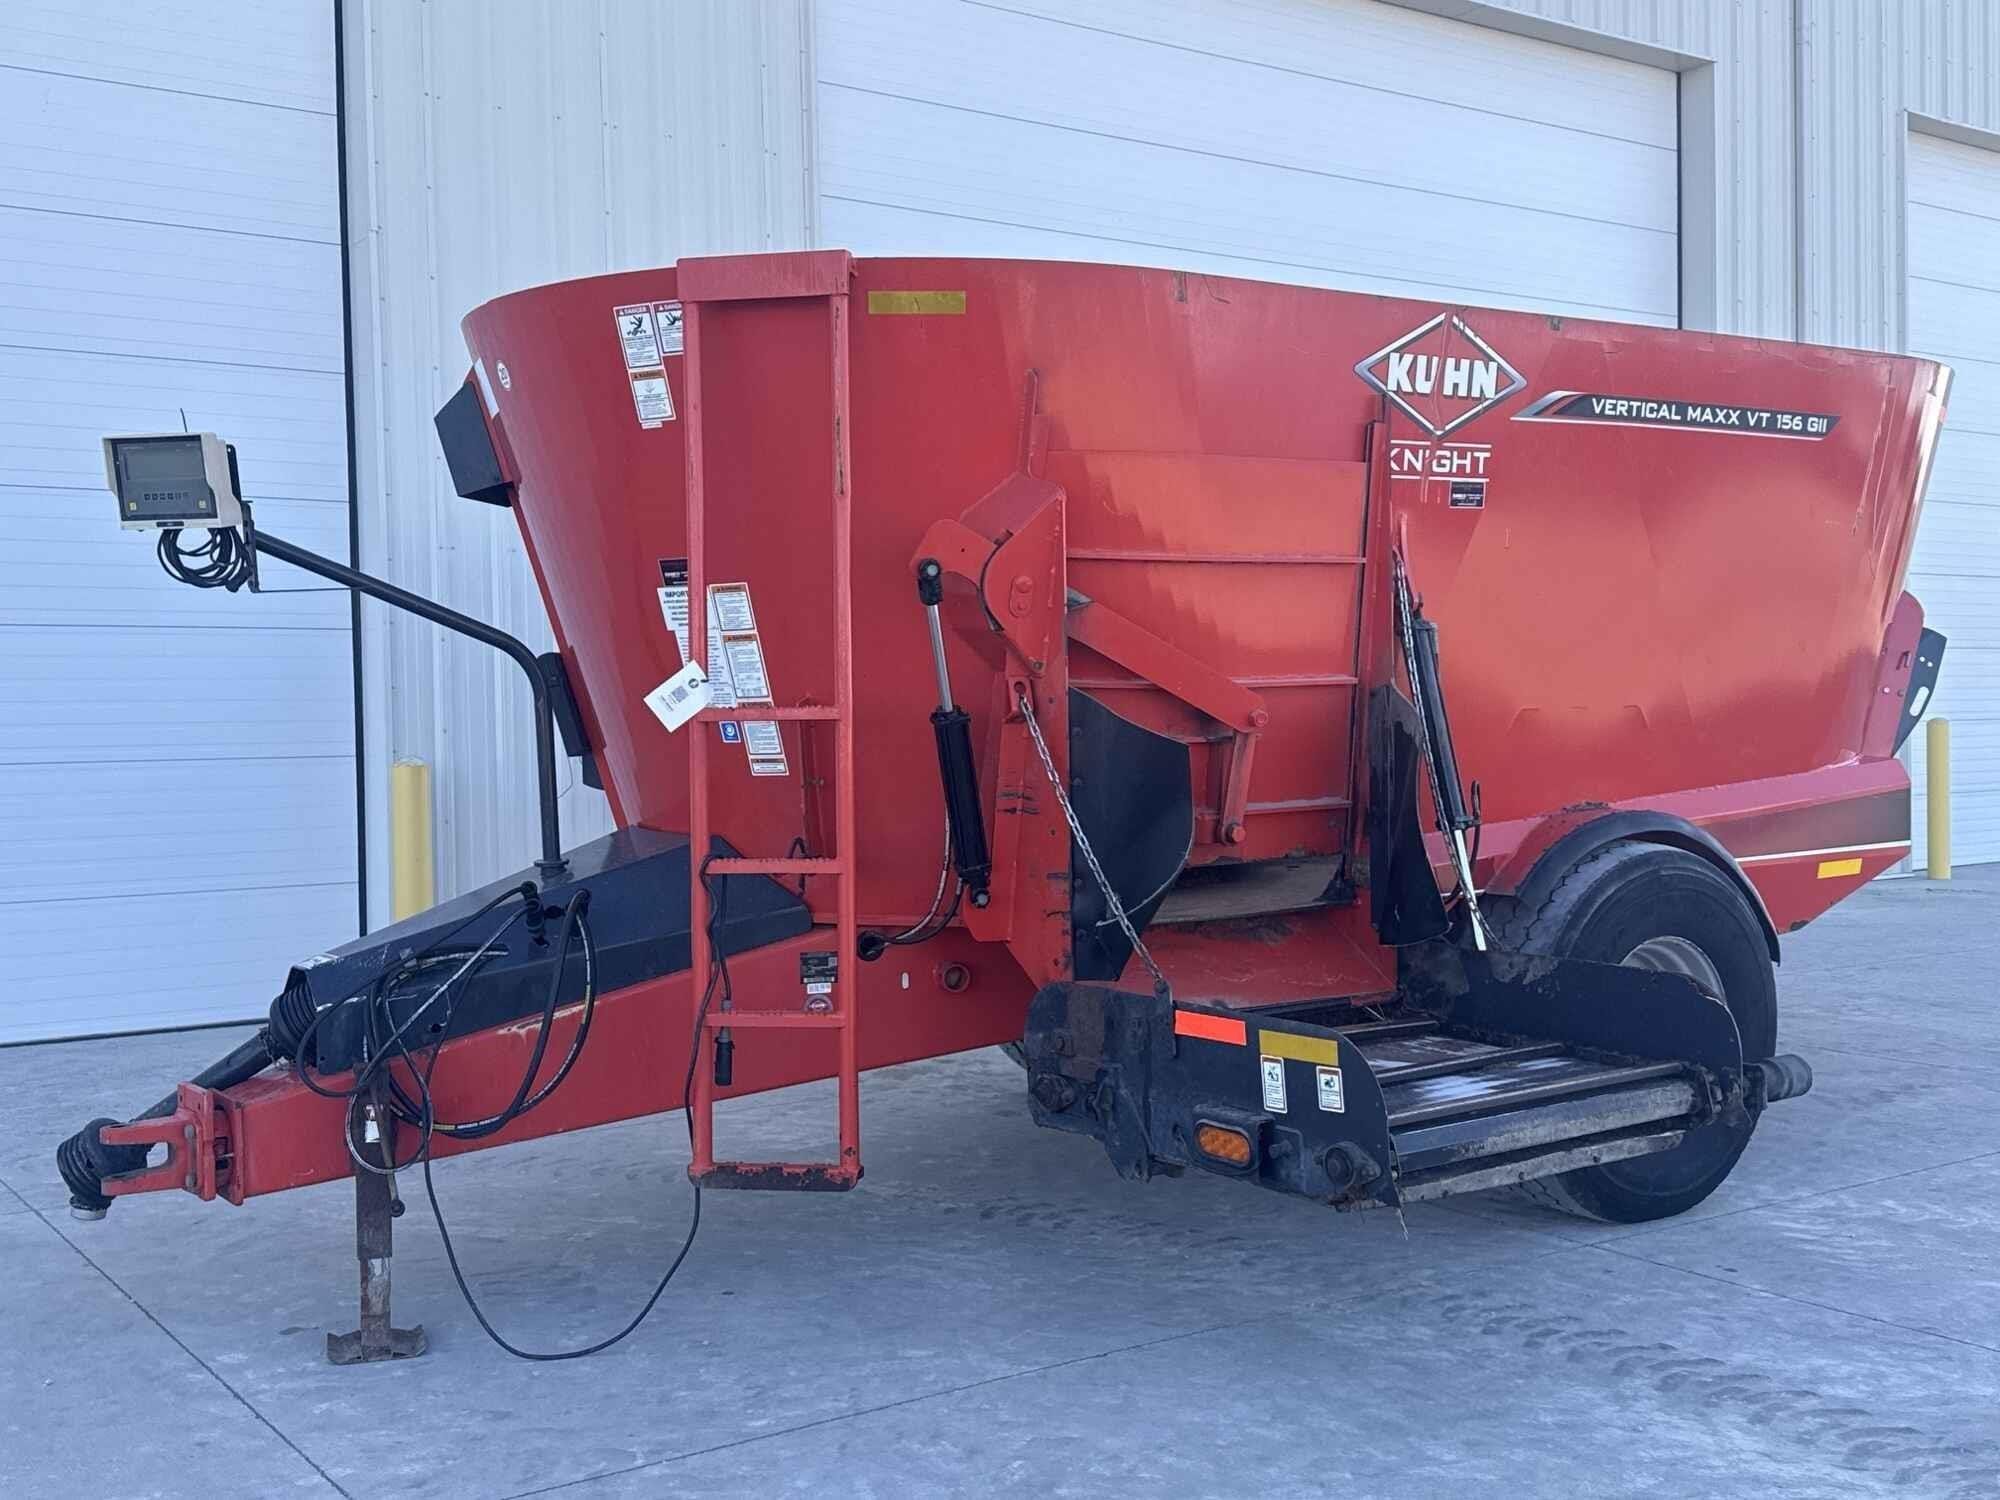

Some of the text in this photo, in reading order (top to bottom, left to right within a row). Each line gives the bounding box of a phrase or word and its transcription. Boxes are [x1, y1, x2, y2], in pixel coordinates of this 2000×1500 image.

[1386, 352, 1498, 399] KUHN
[1591, 398, 1828, 433] VERTICAL MAXX VT 156 GII
